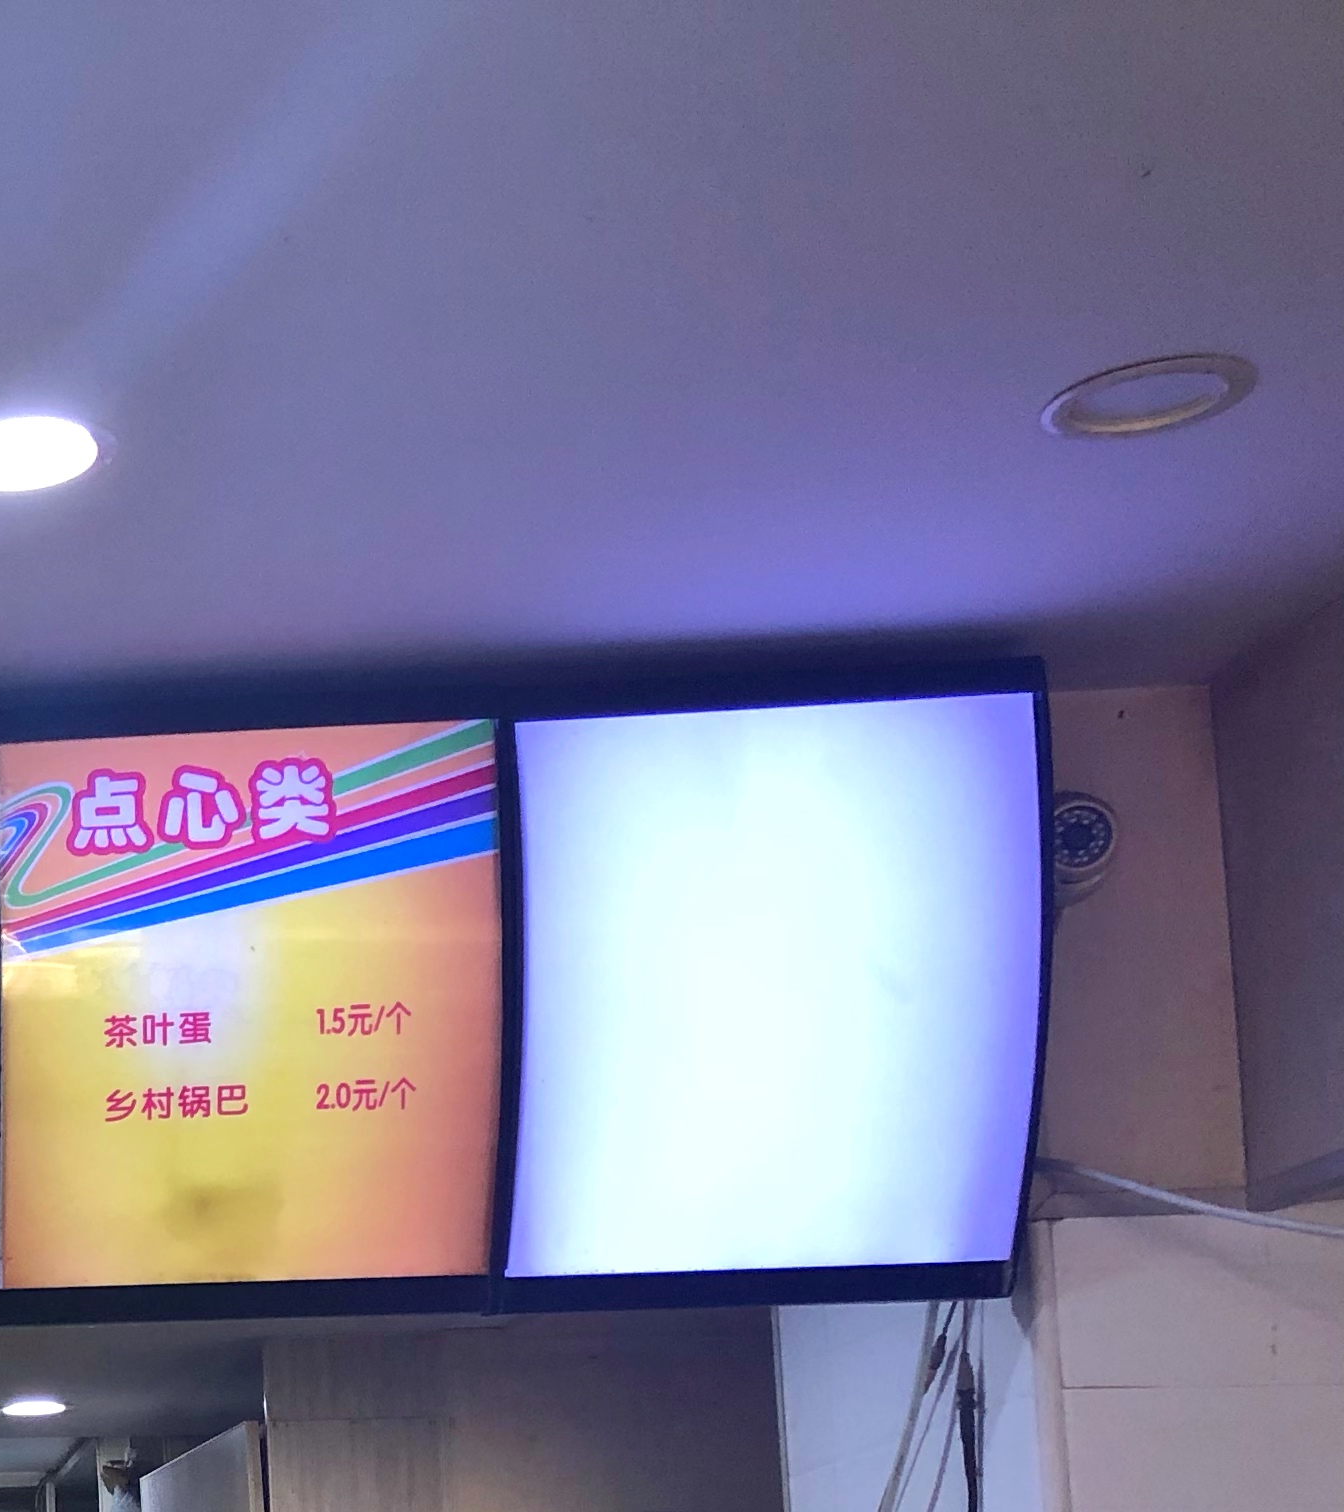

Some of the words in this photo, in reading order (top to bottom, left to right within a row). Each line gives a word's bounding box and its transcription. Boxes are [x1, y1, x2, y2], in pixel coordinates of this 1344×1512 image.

[66, 758, 337, 856] 点心类
[104, 1012, 212, 1048] 茶叶蛋
[316, 1002, 412, 1038] 1.5元/个
[105, 1084, 249, 1122] 乡村锅巴
[315, 1077, 416, 1112] 2.0元/个
